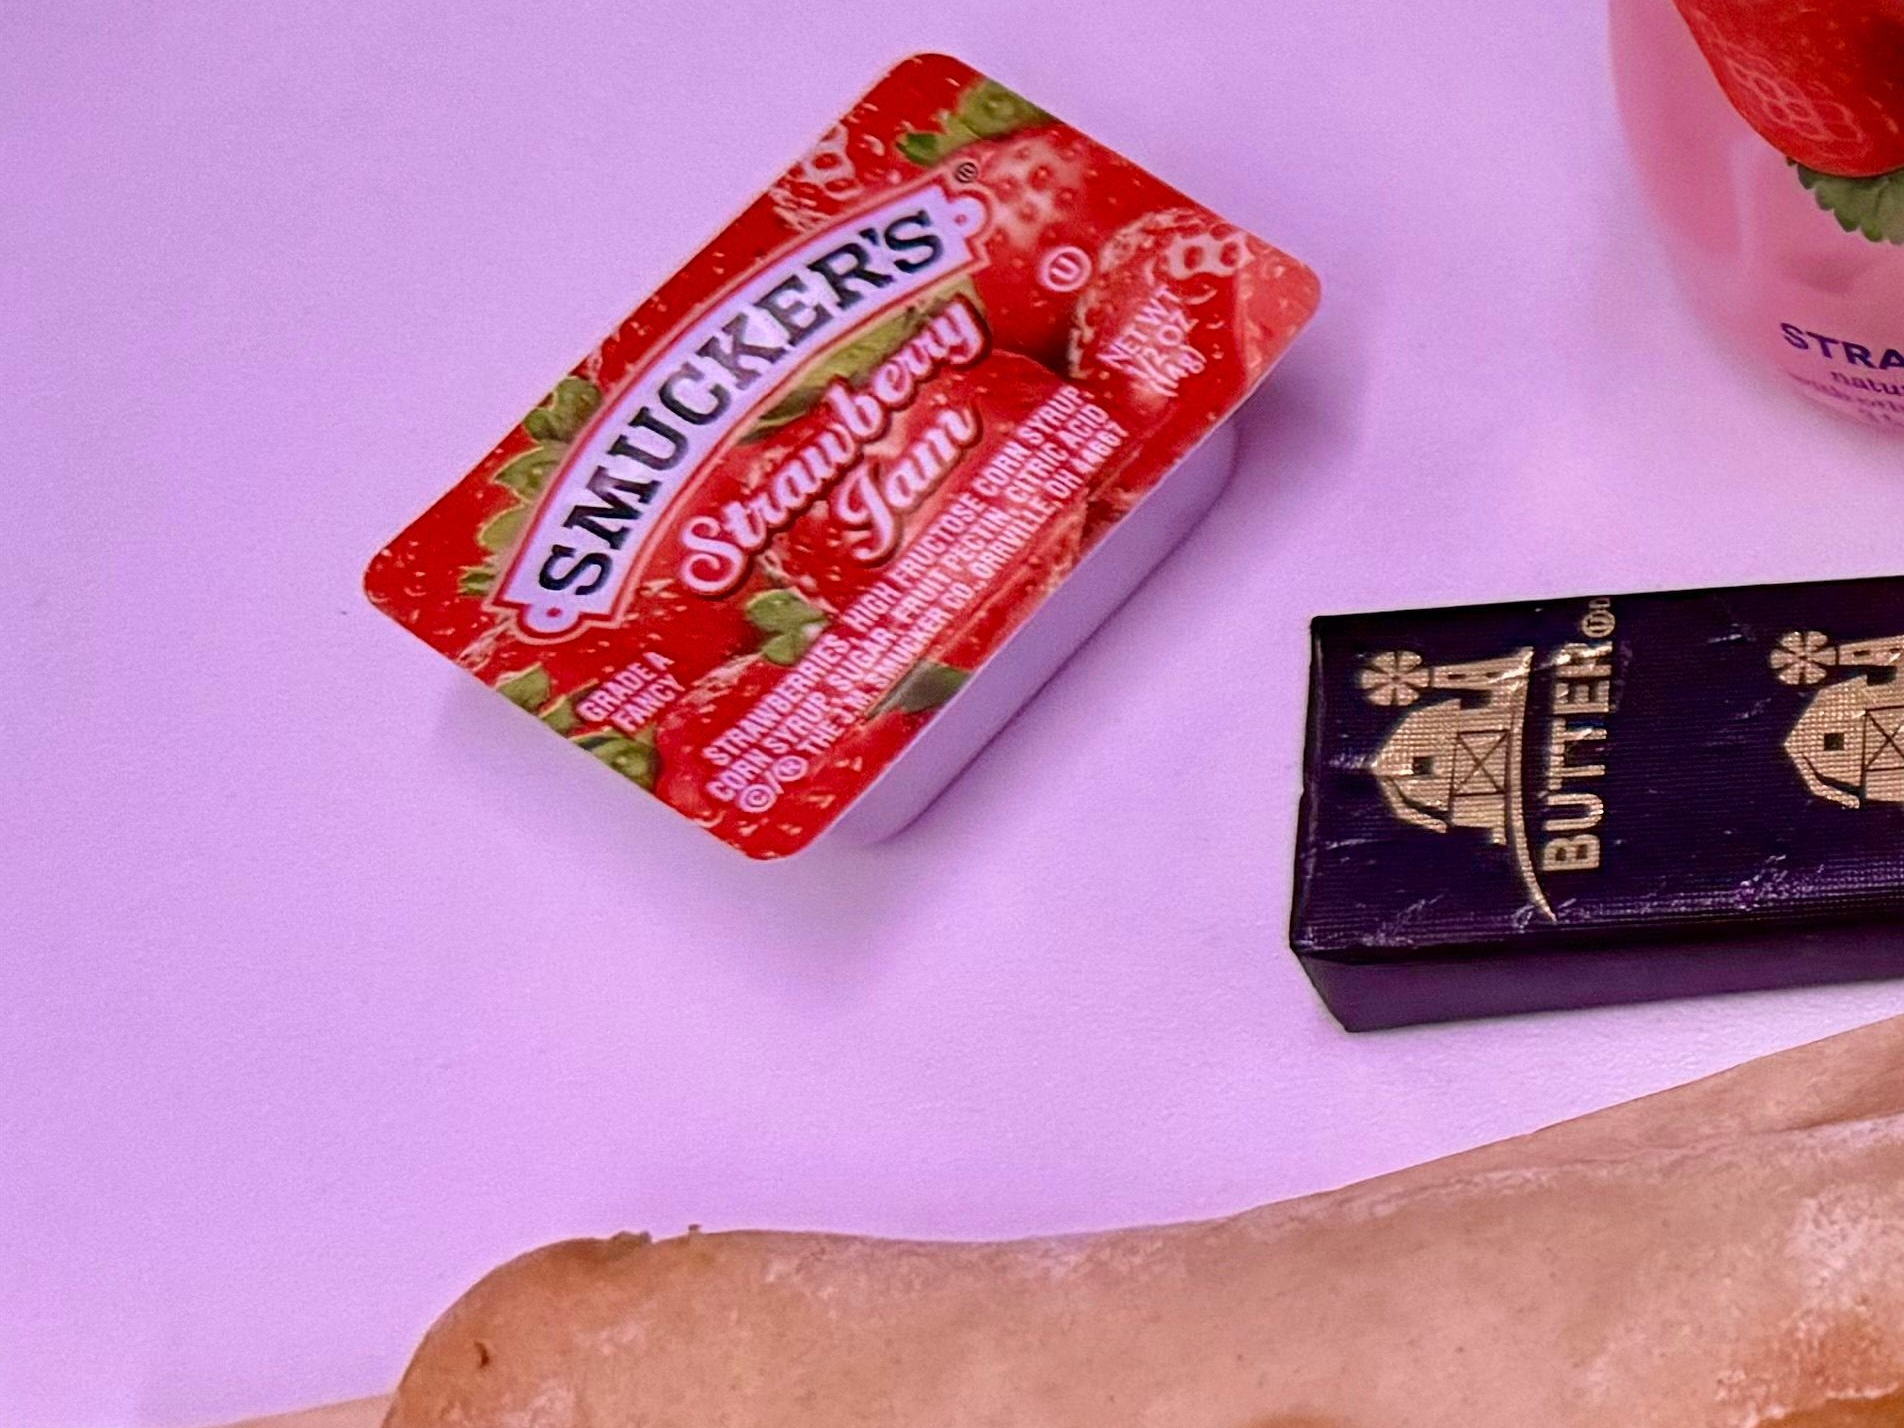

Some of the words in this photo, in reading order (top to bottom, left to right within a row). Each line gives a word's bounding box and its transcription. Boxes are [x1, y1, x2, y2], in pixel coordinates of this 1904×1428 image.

[543, 209, 941, 593] SMUCKER'S
[1095, 323, 1149, 370] NET
[1133, 281, 1181, 325] WT
[1155, 307, 1199, 345] OZ
[687, 296, 975, 588] Strawberry
[835, 409, 980, 560] Jam
[577, 660, 653, 725] GRADE
[646, 648, 674, 671] A
[703, 631, 863, 765] STRAWBERRIES,
[841, 579, 901, 633] HIGH
[888, 491, 986, 589] FRUCTOSE
[973, 439, 1031, 498] CORN
[1016, 383, 1094, 446] SYRUP,
[705, 745, 773, 803] CORN
[762, 688, 840, 755] SYRUP,
[827, 626, 904, 694] SUGAR,
[890, 565, 951, 623] FRUIT
[941, 503, 1021, 573] PECTIN,
[1004, 440, 1070, 504] CITRIC
[1057, 400, 1110, 450] ACID
[796, 716, 845, 755] THE
[863, 604, 953, 691] SMUCKER
[1044, 467, 1083, 501] OH
[610, 672, 682, 734] FANCY
[1542, 642, 1614, 872] BUTTER
